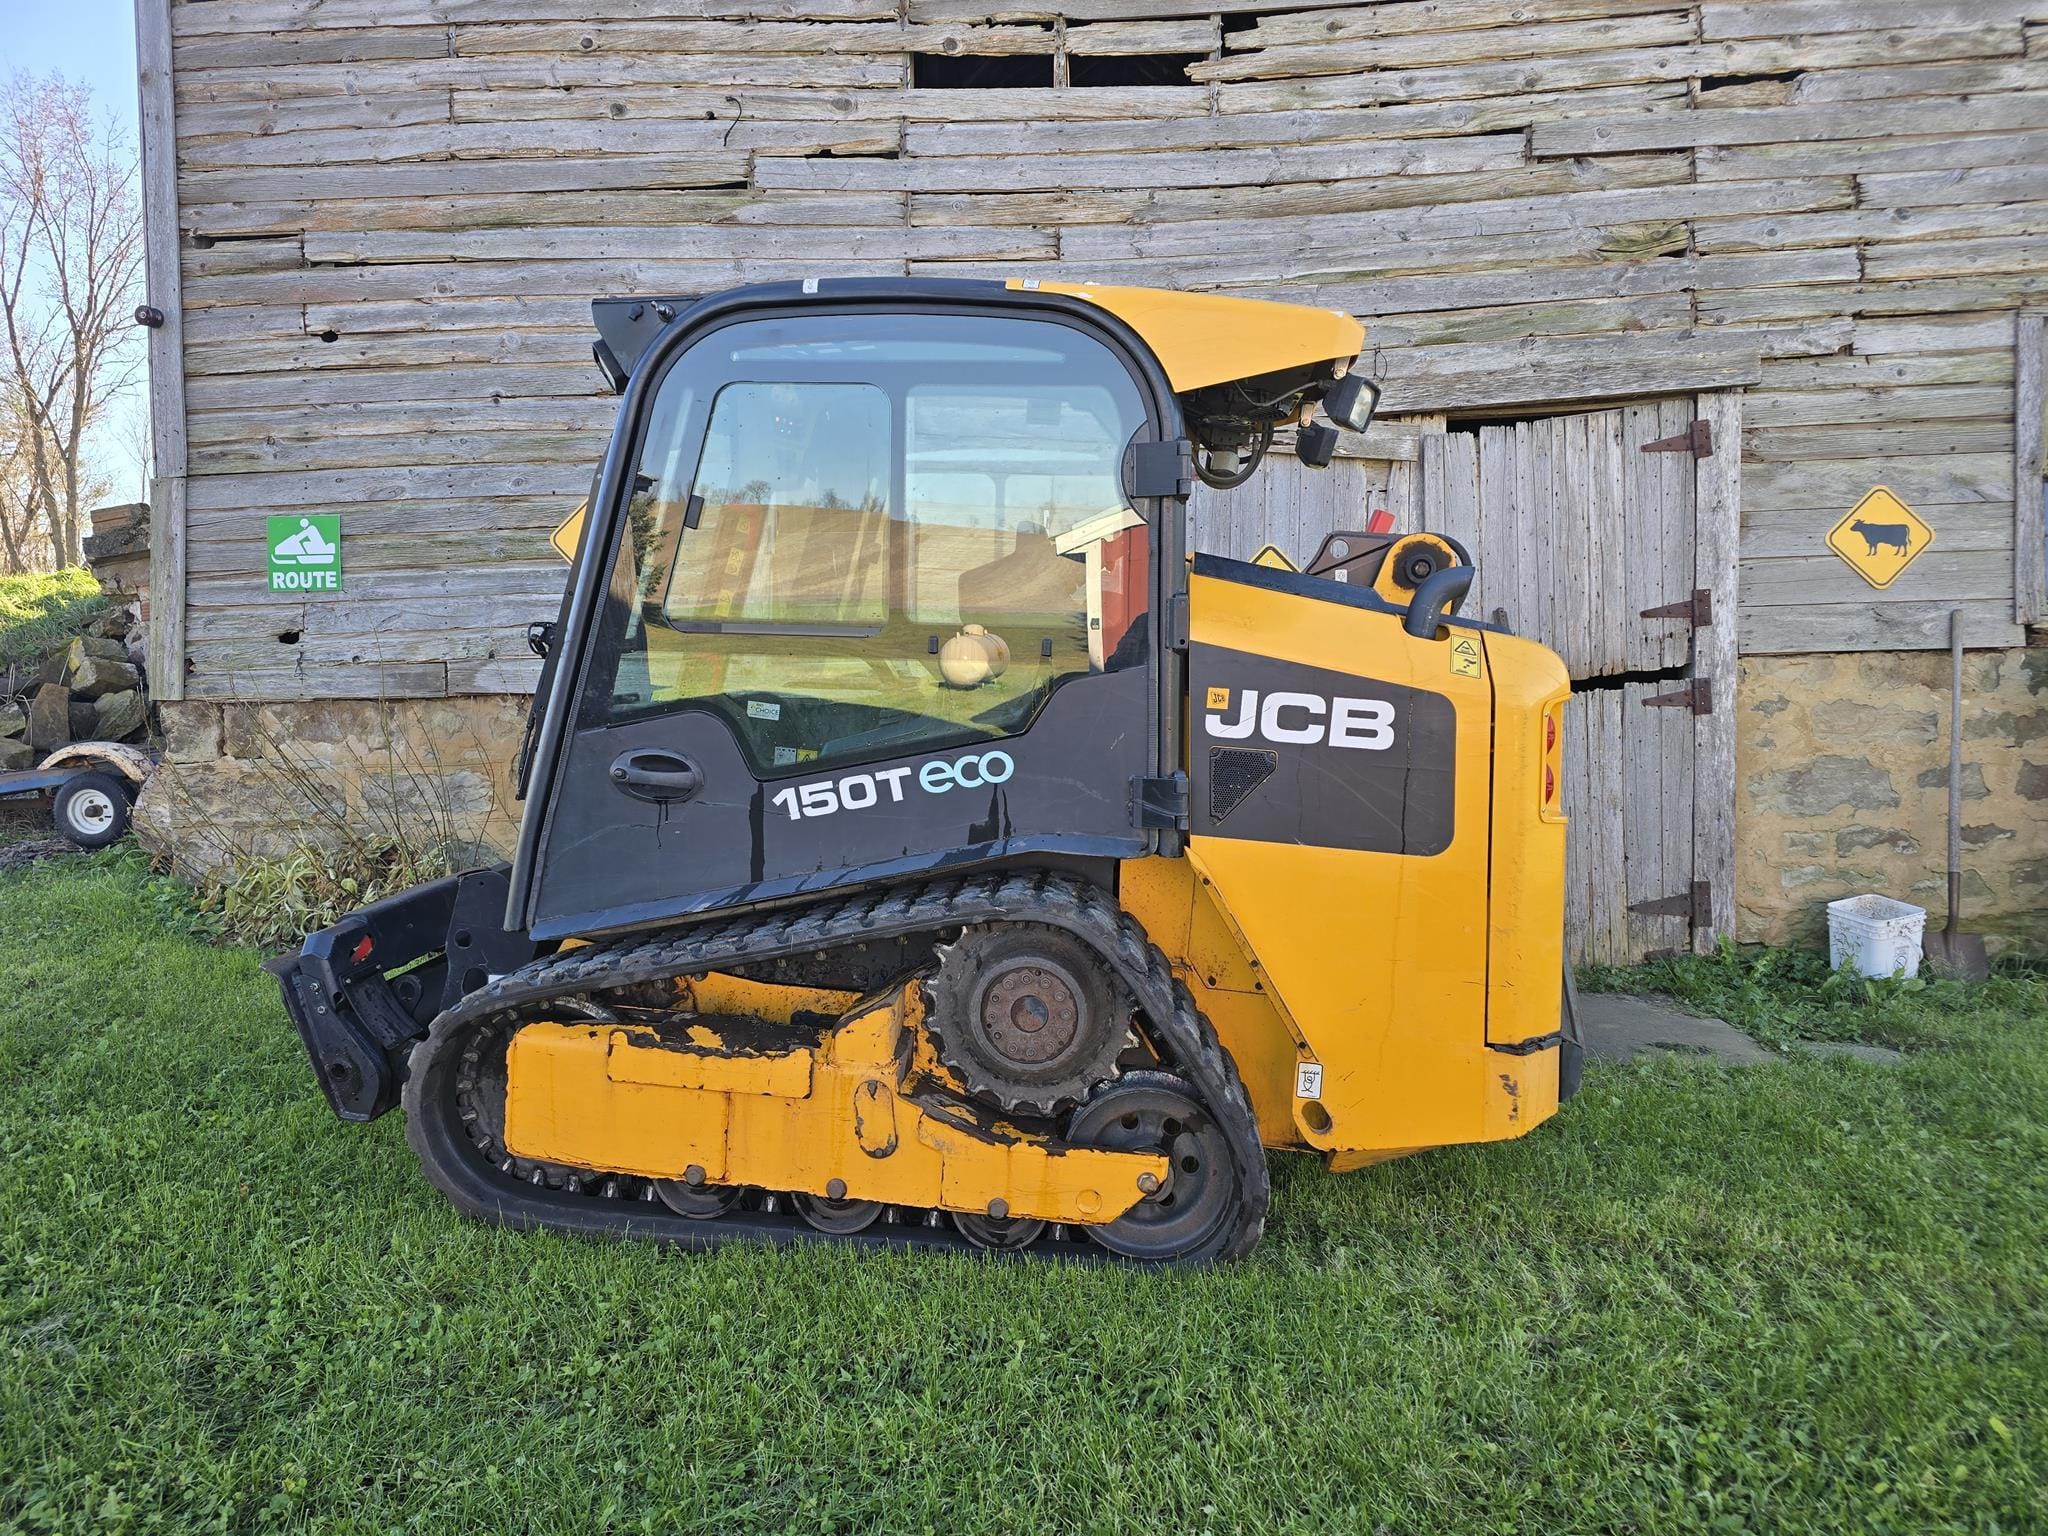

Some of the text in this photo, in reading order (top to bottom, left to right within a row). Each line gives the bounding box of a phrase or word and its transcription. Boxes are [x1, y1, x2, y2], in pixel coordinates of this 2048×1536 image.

[272, 571, 337, 589] ROUTE
[1205, 689, 1395, 751] JCB
[772, 750, 1015, 820] 150T eco
